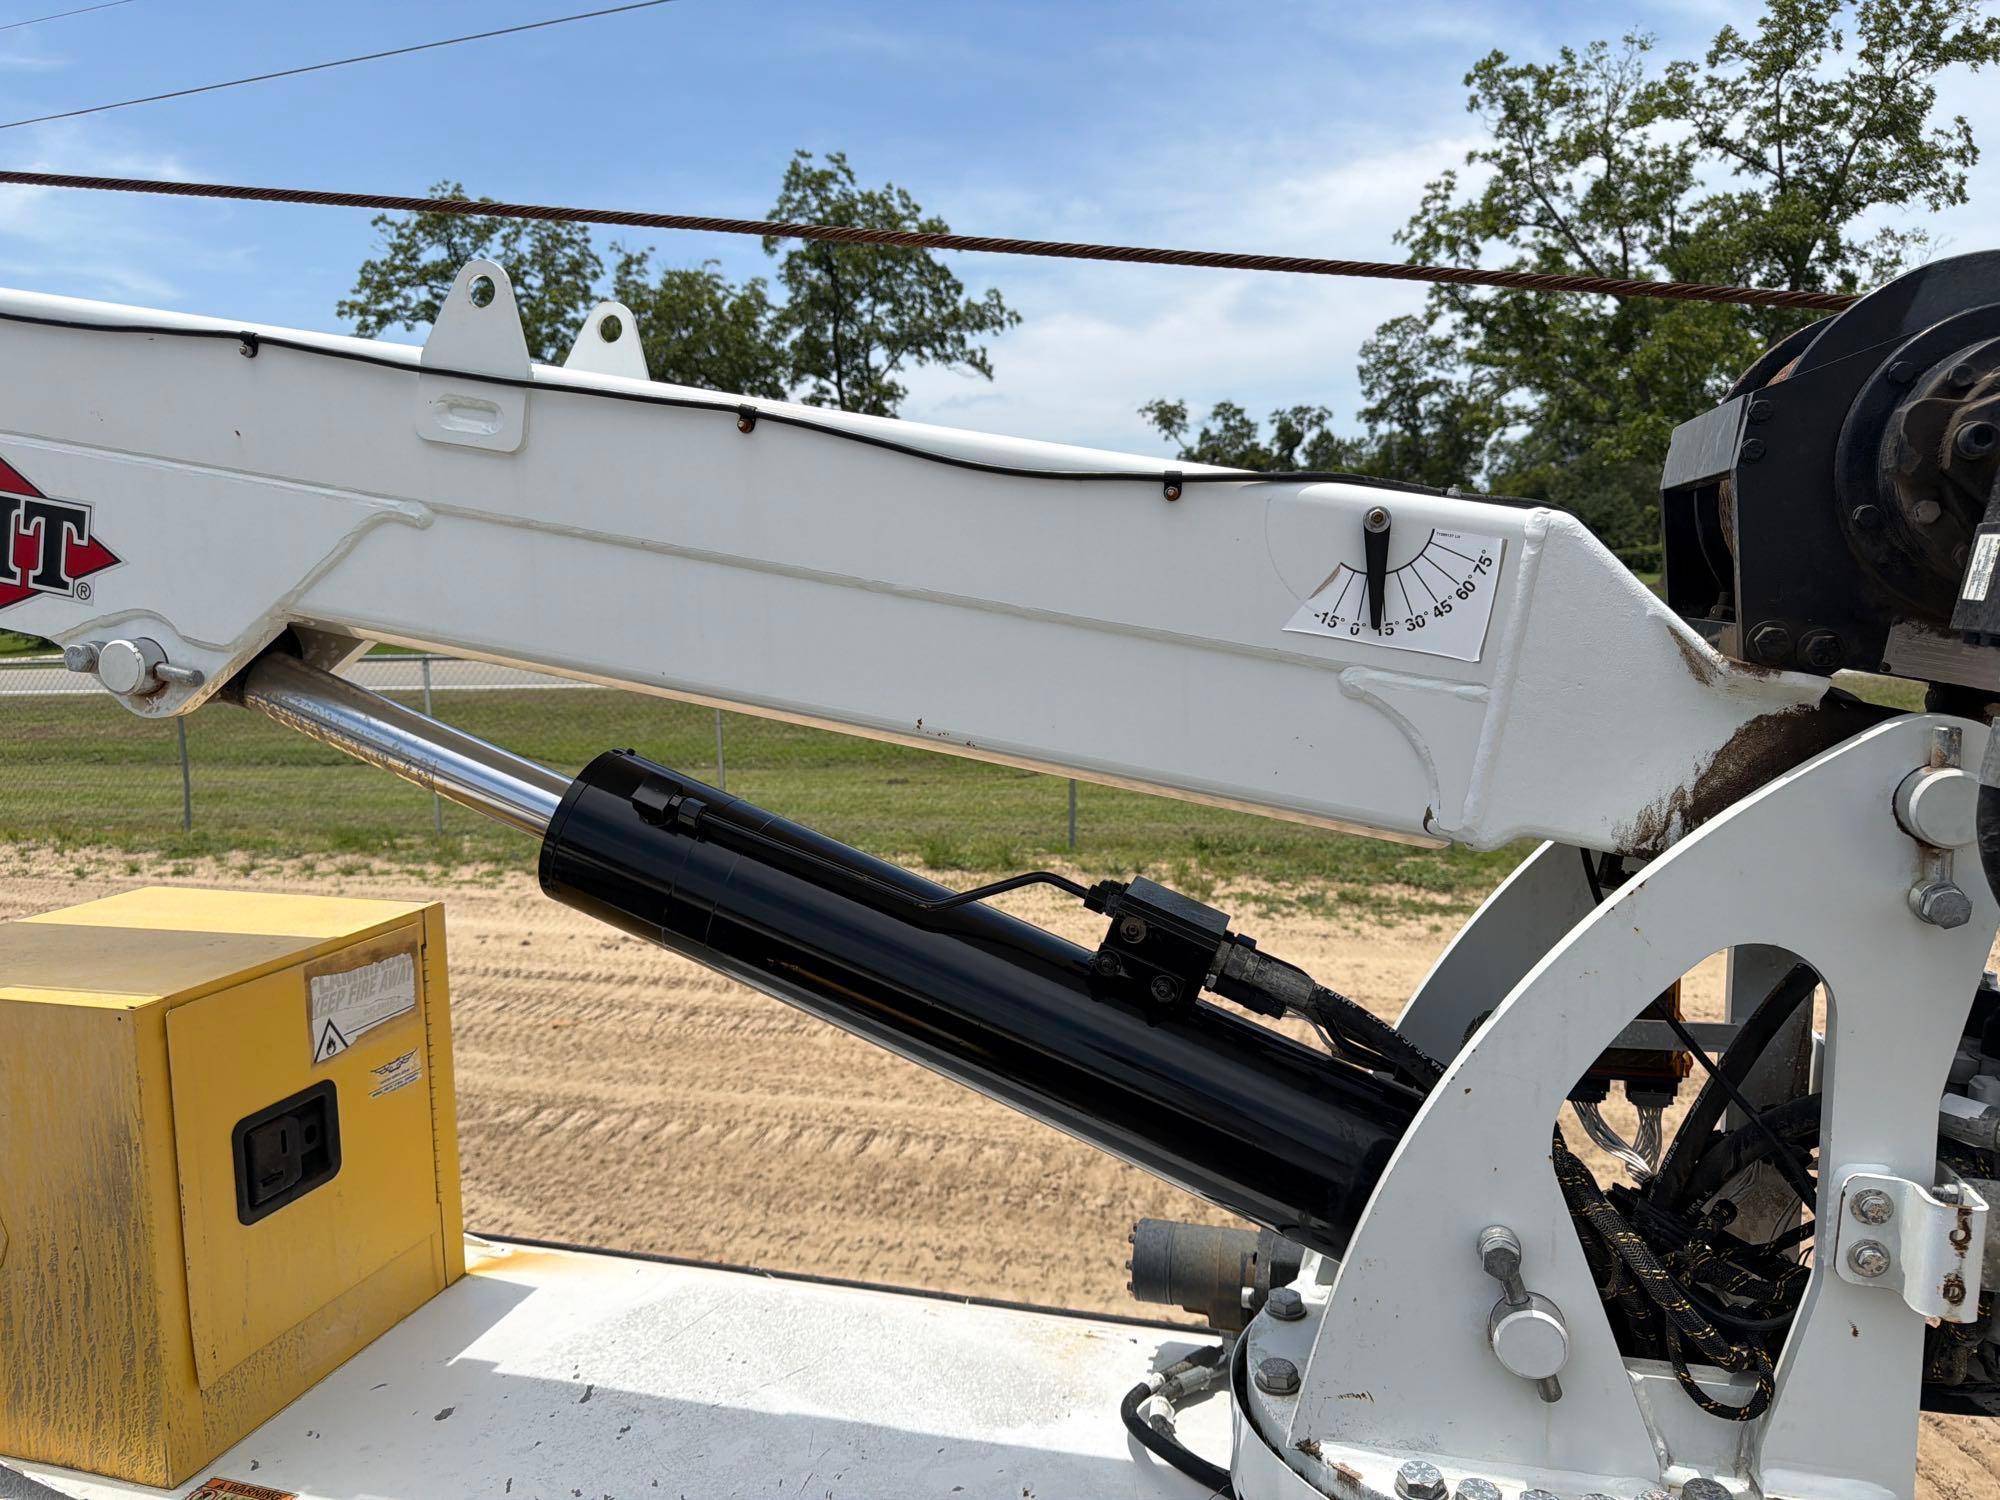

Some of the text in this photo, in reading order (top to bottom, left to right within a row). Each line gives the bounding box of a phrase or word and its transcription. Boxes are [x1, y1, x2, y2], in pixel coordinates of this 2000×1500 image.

[1350, 622, 1366, 636] 0°
[1405, 611, 1429, 632] 30°
[1433, 595, 1453, 618] 45°
[1456, 574, 1477, 601] 60°
[1473, 549, 1493, 577] 75°
[348, 977, 378, 1005] FIRE
